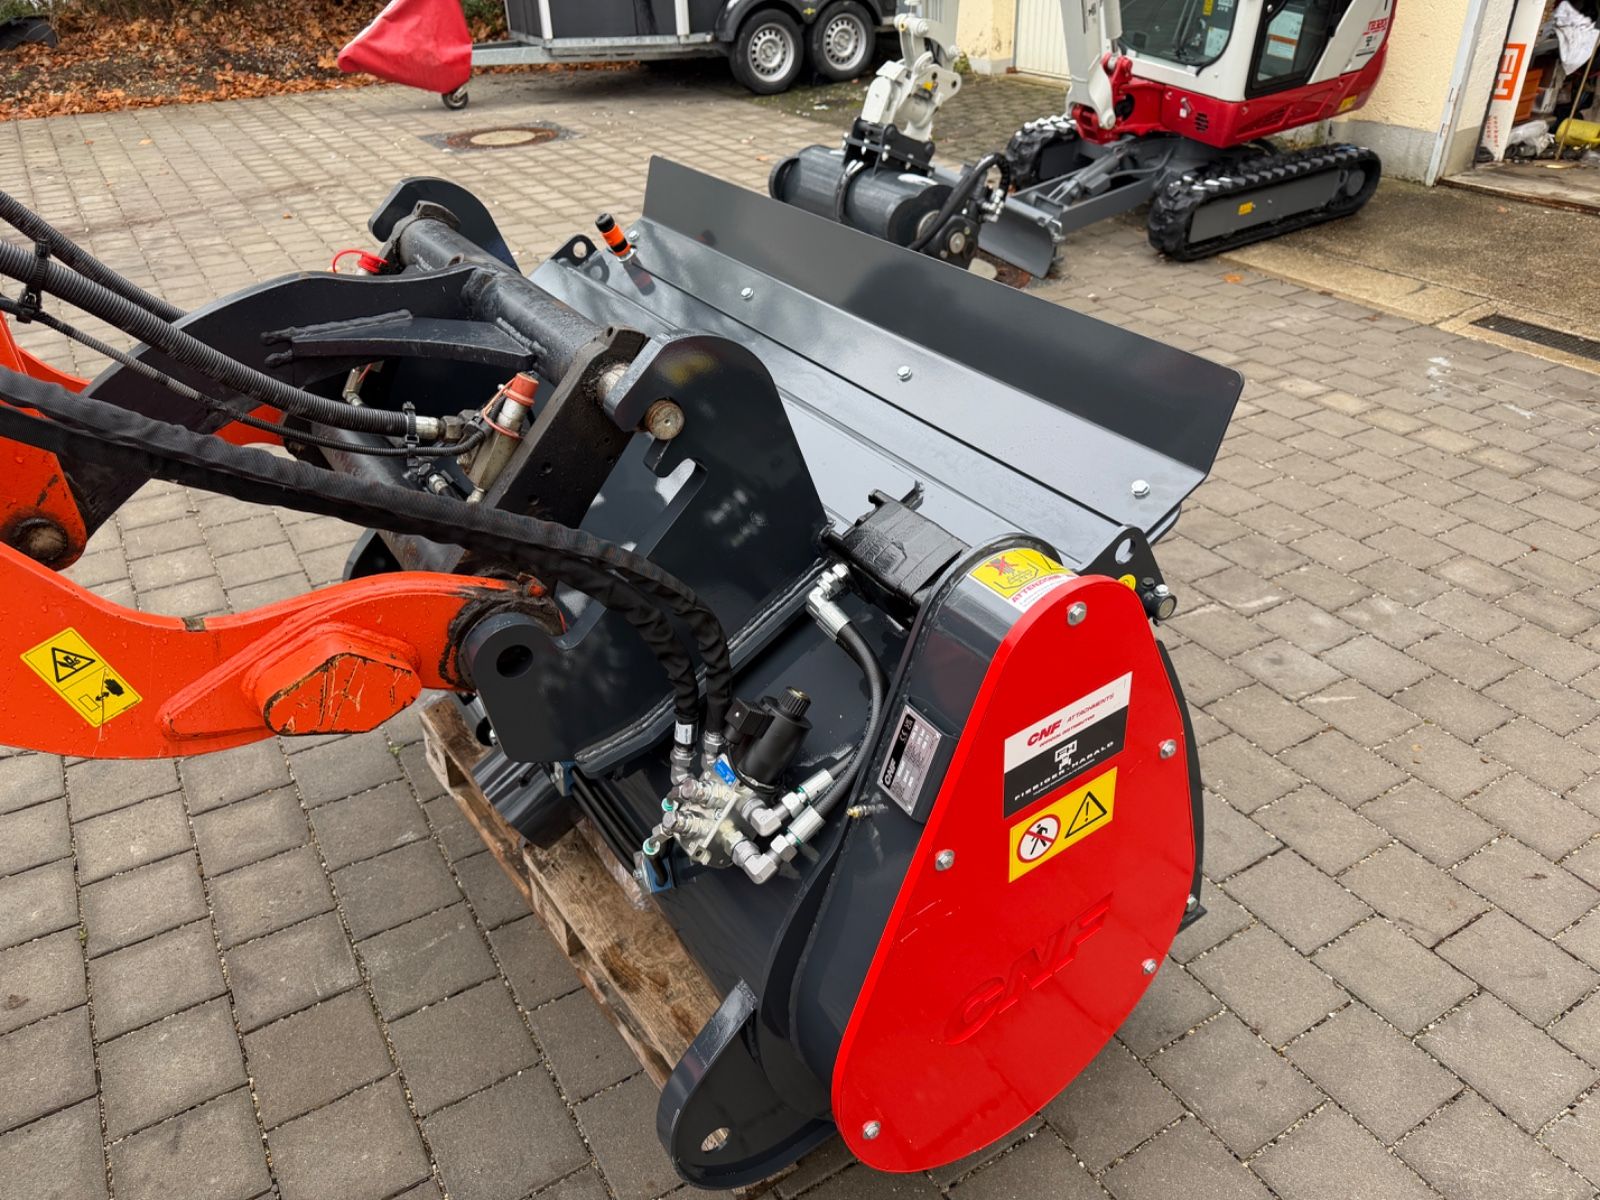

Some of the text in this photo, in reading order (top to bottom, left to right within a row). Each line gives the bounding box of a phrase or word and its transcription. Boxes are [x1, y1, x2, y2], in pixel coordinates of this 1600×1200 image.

[1027, 718, 1063, 747] CNF
[884, 758, 897, 787] CNF
[944, 890, 1114, 1045] CNF
